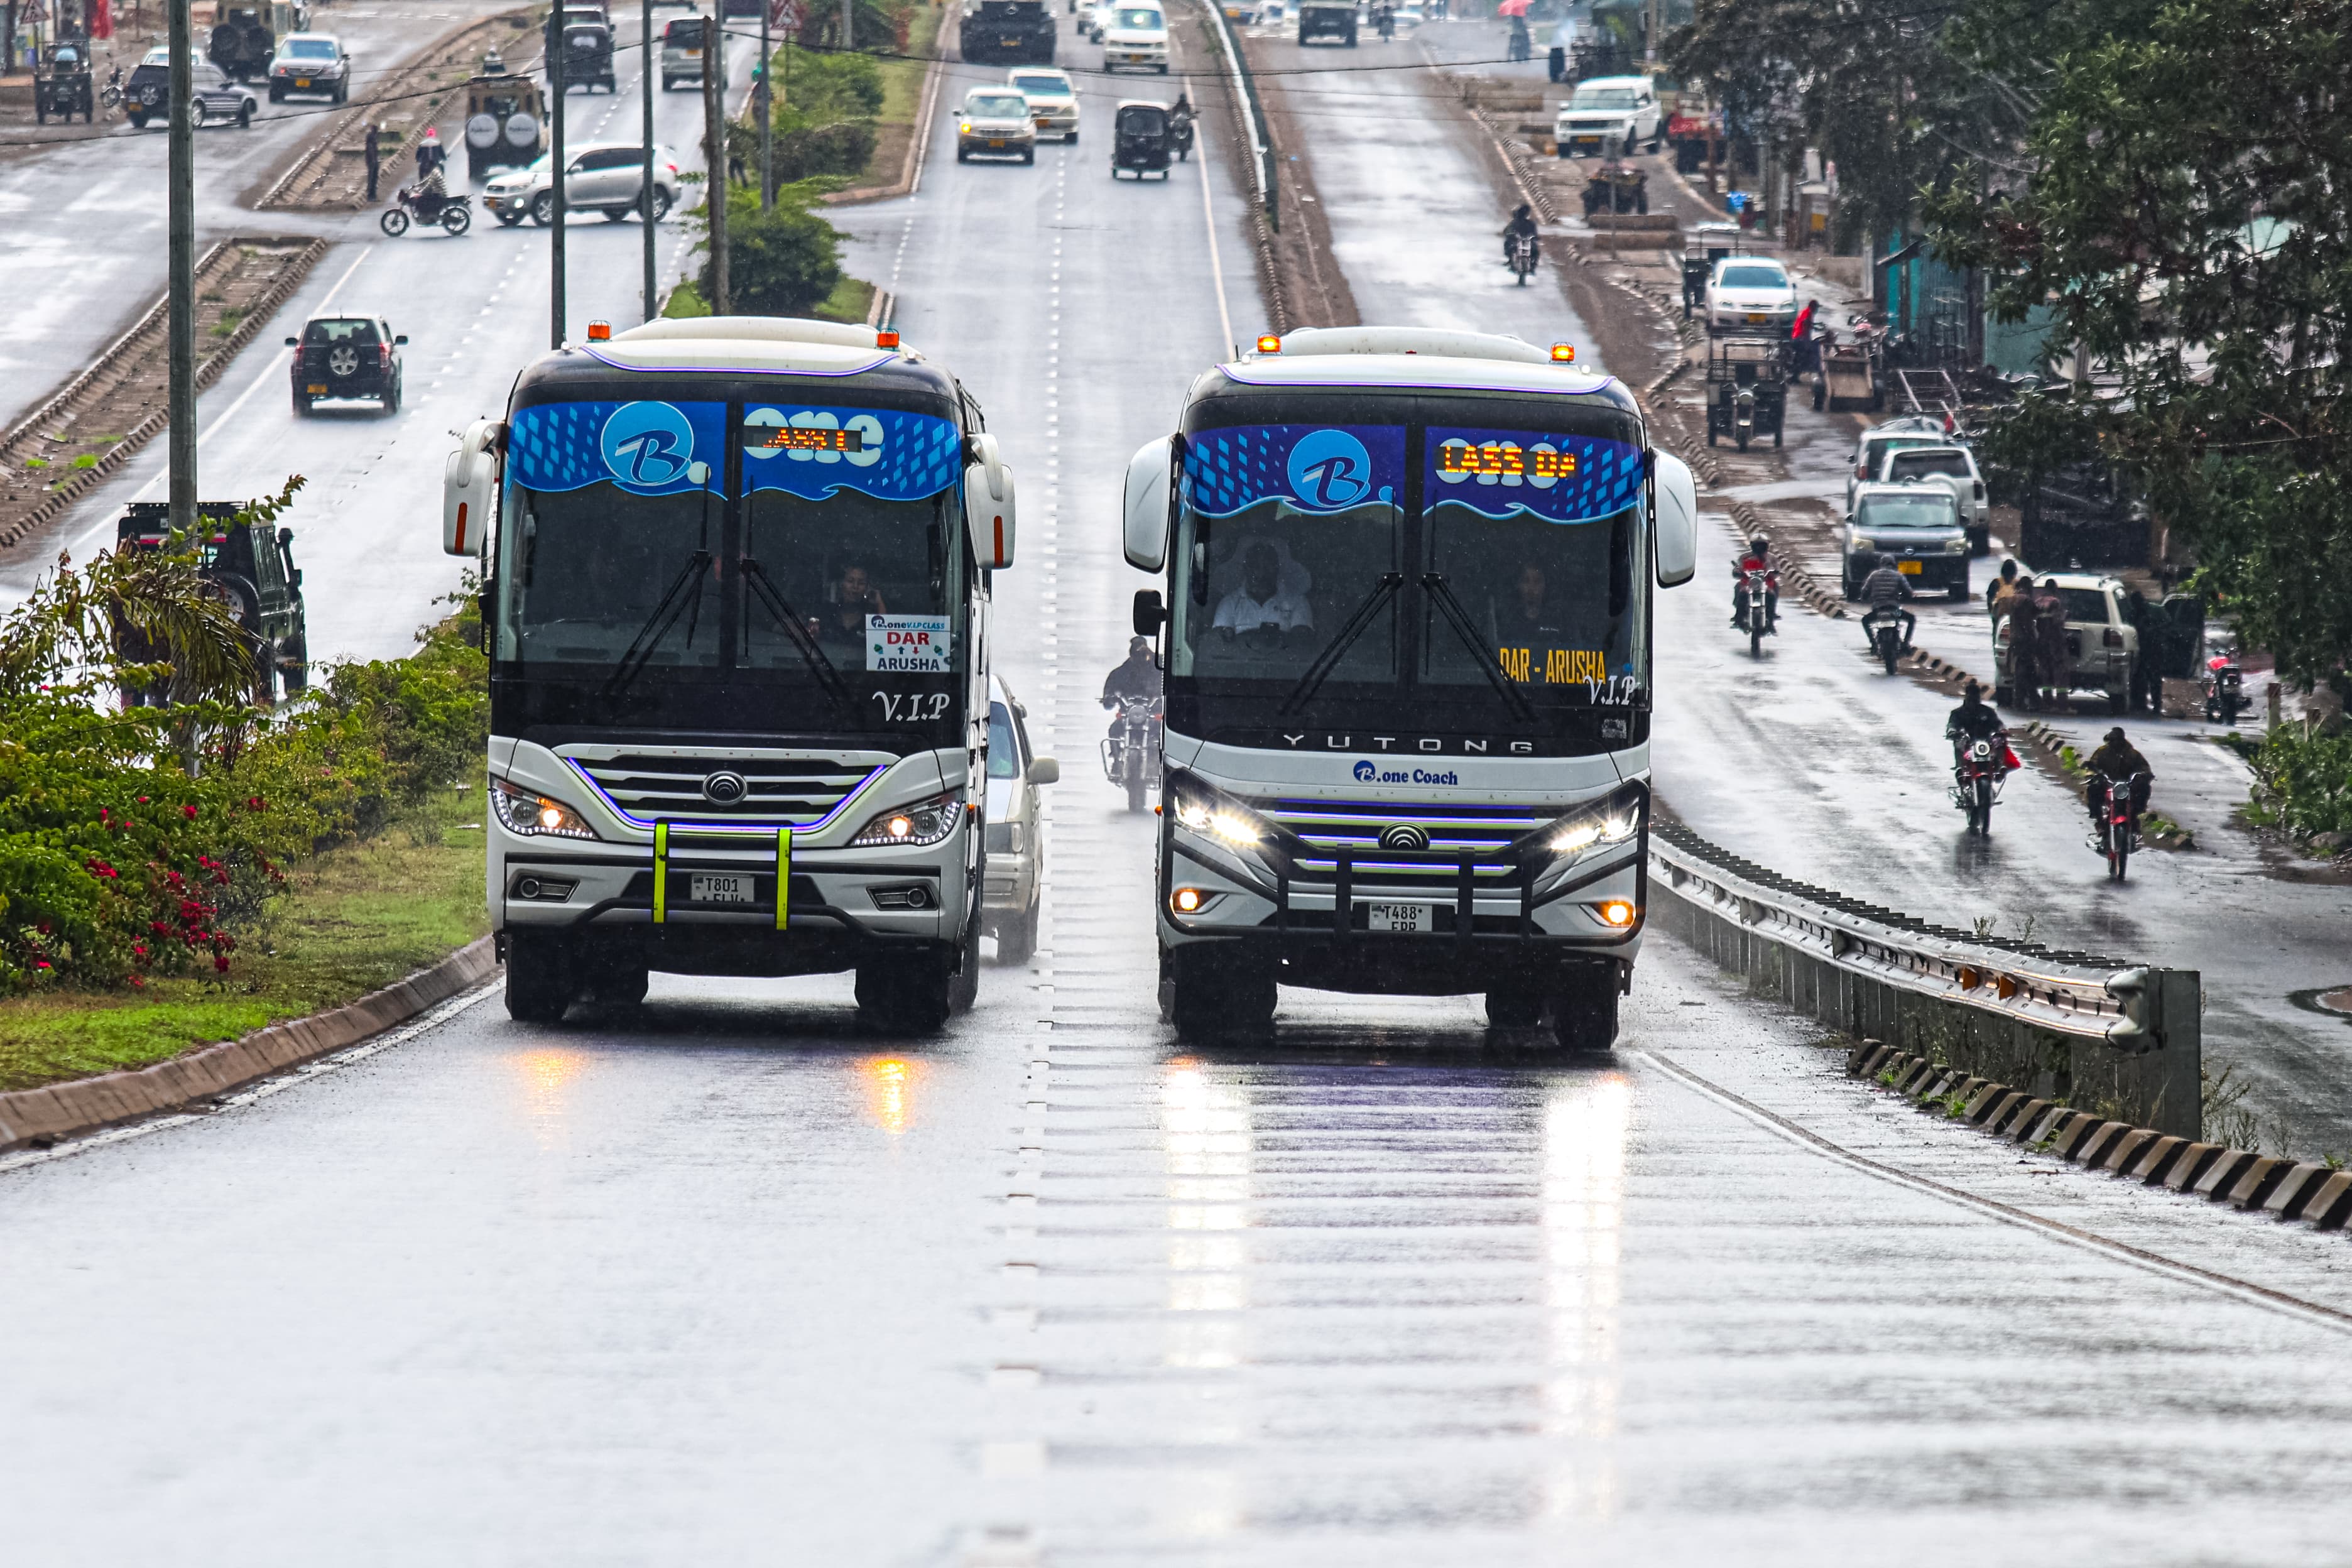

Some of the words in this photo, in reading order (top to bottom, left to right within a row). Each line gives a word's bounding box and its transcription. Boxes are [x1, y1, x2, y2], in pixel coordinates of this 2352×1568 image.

[886, 631, 930, 646] DAR
[876, 658, 940, 672] ARUSHA
[1500, 647, 1530, 683] DAR
[1545, 649, 1606, 684] ARUSHA
[1583, 675, 1636, 705] V.I.P
[872, 691, 950, 722] V.I.P
[1283, 734, 1533, 753] YUTONG
[1413, 769, 1458, 785] Coach
[705, 878, 738, 892] T801
[1383, 906, 1417, 920] T488
